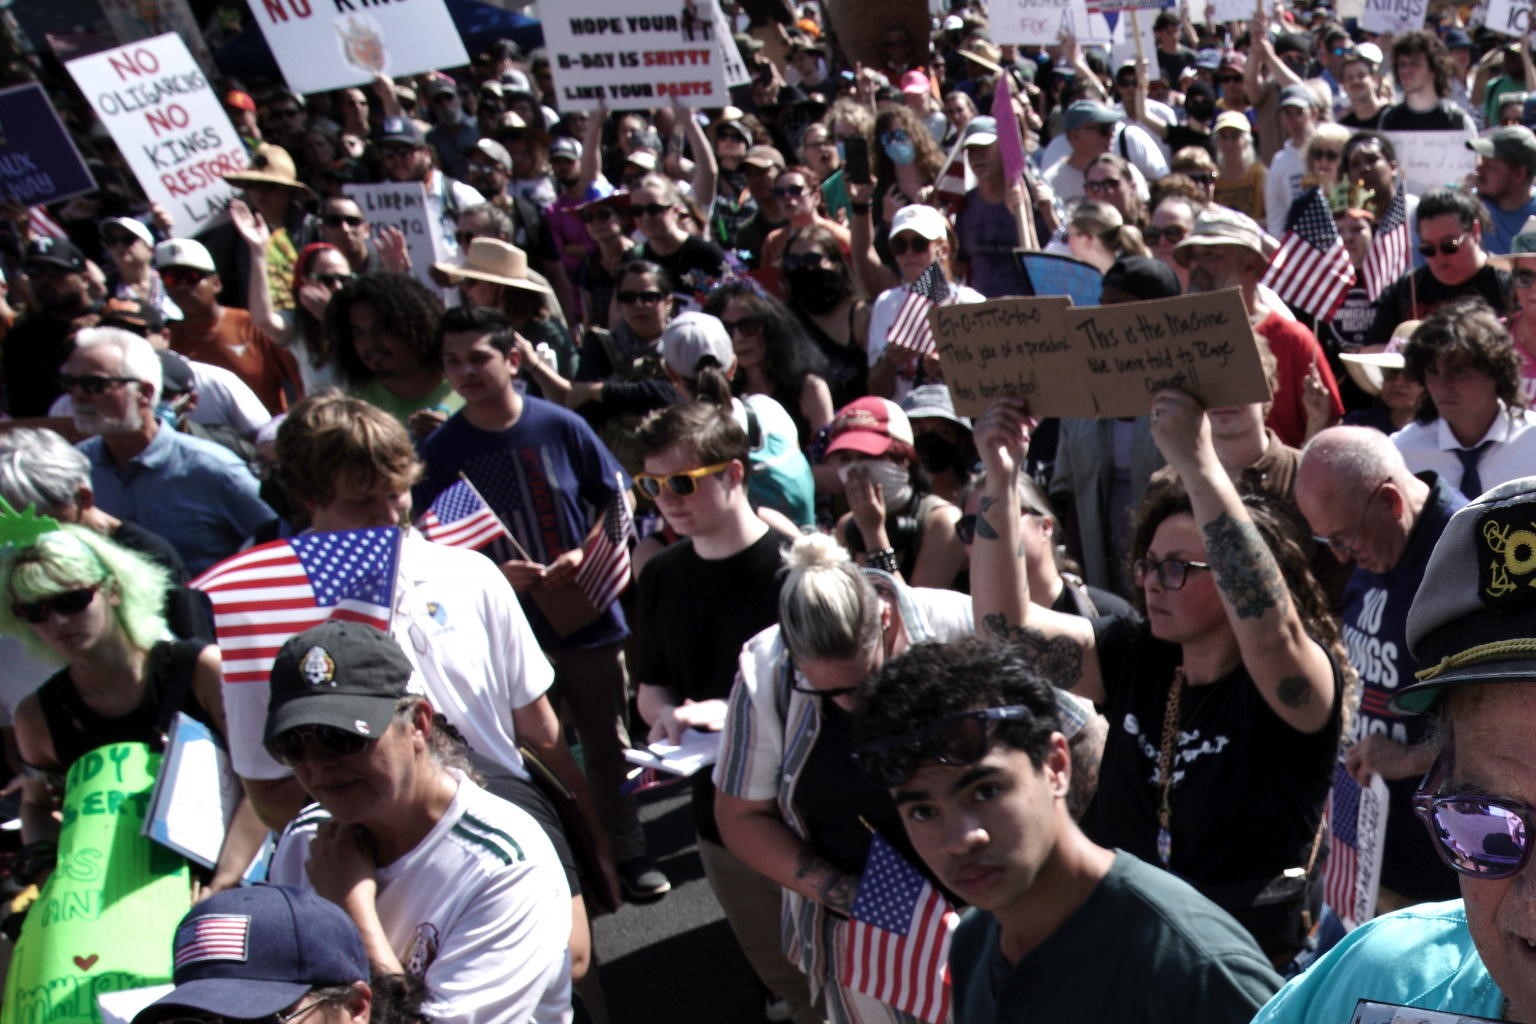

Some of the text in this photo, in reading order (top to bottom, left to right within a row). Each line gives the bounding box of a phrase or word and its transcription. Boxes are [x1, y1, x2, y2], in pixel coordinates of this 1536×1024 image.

[569, 16, 678, 35] HOPE YOUR
[108, 48, 160, 81] NO
[558, 53, 616, 69] B-DAY
[619, 52, 639, 67] IS
[643, 50, 711, 67] SHITTY
[98, 70, 206, 116] OLIGARCHS
[564, 85, 605, 100] LIKE
[609, 83, 654, 98] YOUR
[144, 104, 189, 137] NO
[142, 126, 222, 169] KINGS
[161, 148, 248, 198] RESTORE
[1075, 316, 1119, 352] This
[1356, 587, 1388, 636] NO
